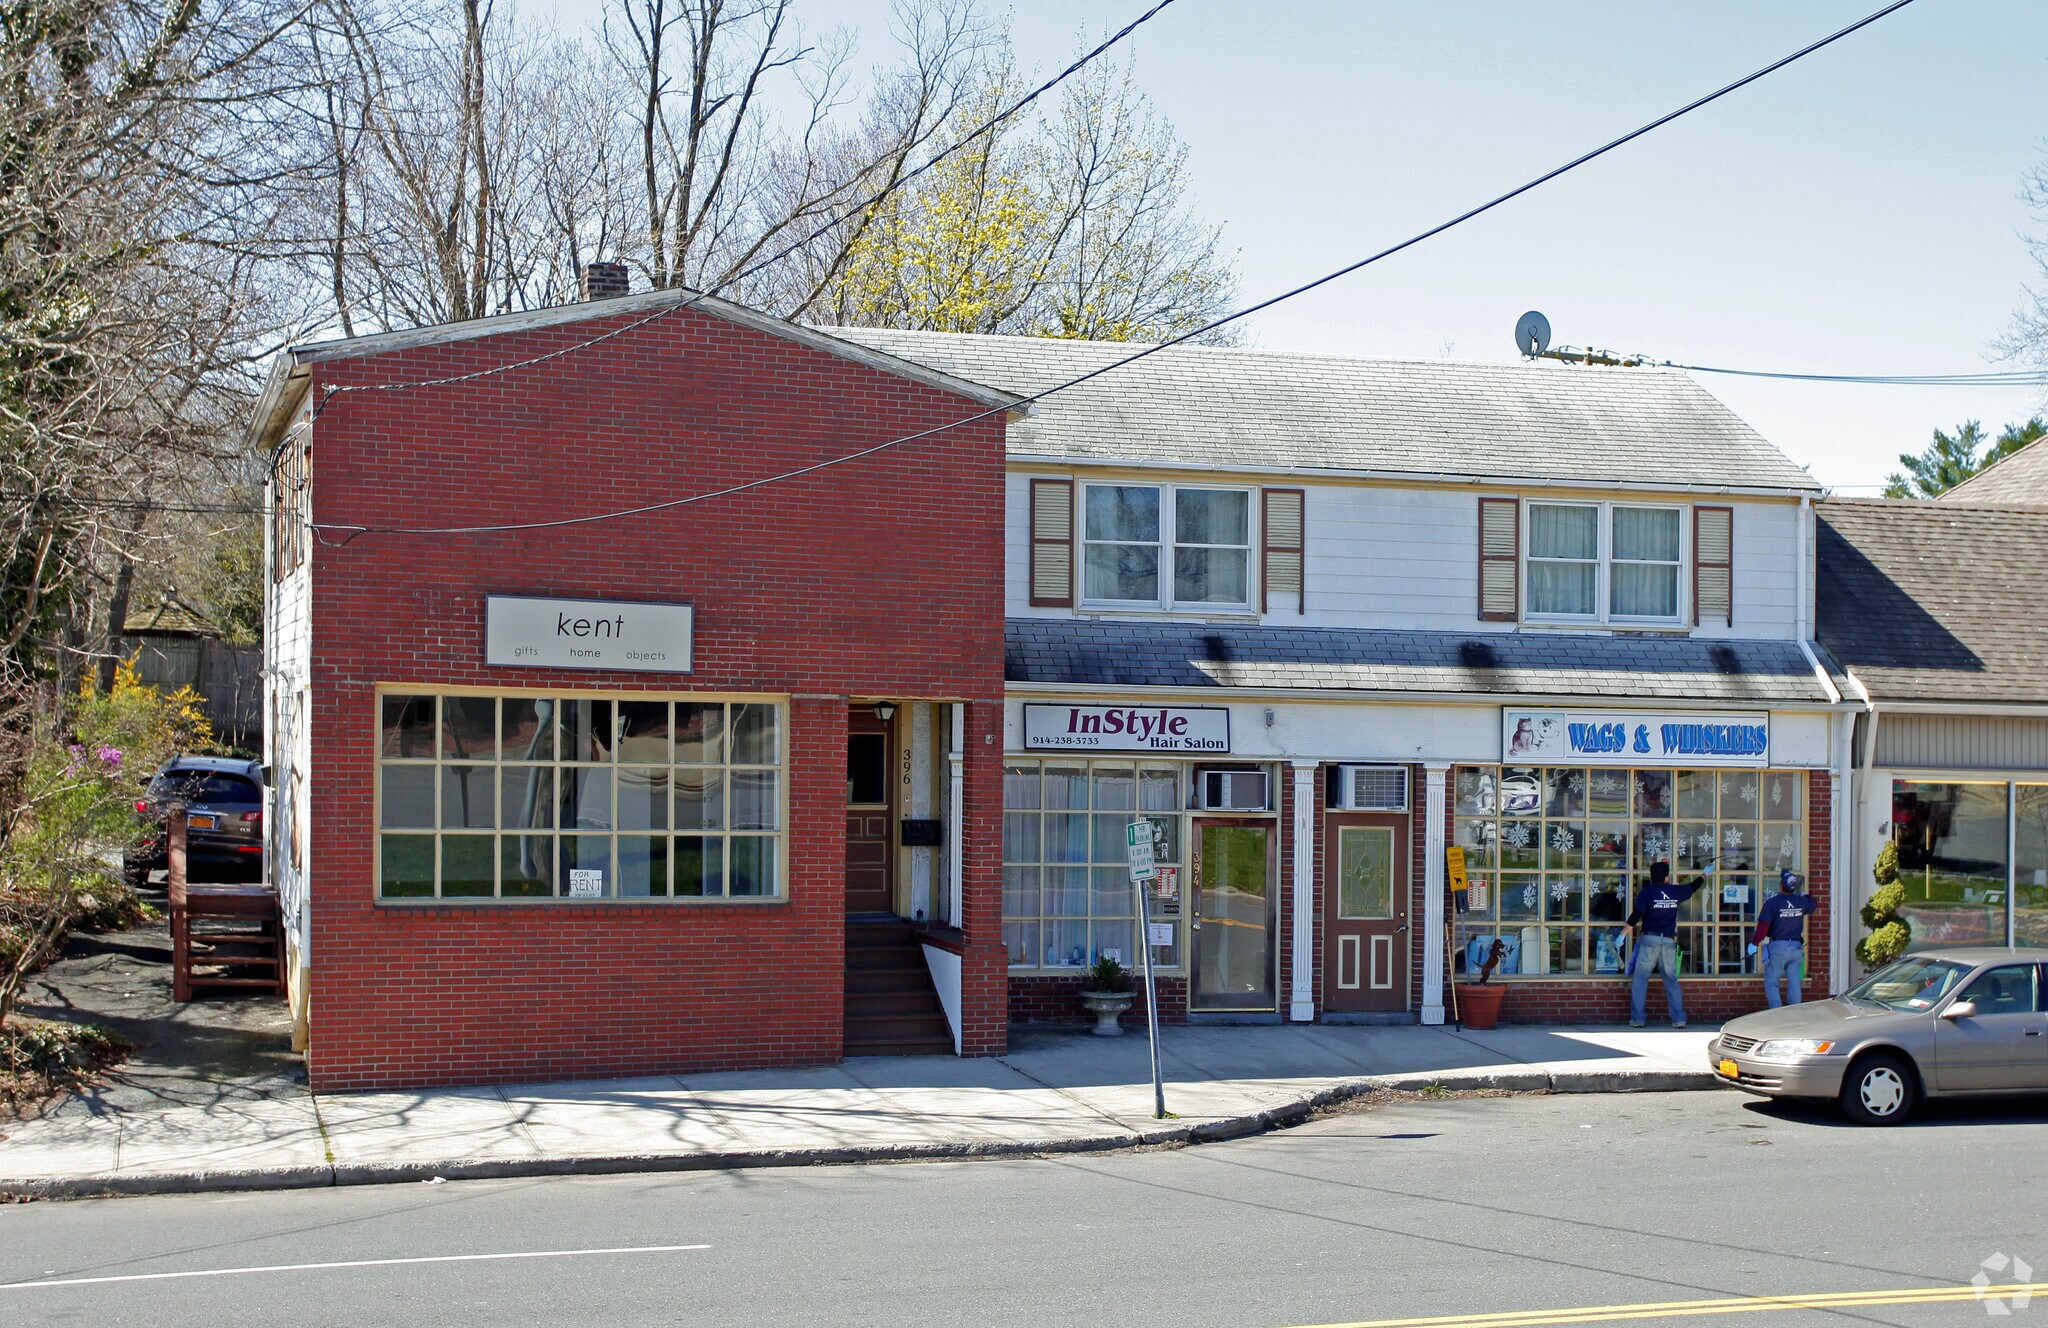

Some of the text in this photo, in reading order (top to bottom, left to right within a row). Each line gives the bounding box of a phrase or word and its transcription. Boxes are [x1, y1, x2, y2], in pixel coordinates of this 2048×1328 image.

[557, 612, 624, 637] kent
[514, 646, 666, 661] gifts home objects
[1067, 709, 1188, 742] InStyle
[1033, 736, 1099, 745] 914-238-3733
[1150, 737, 1224, 749] Hair Salon
[1567, 722, 1767, 756] WAGS & WHISKERS
[903, 749, 911, 785] 396
[569, 879, 602, 892] RENT
